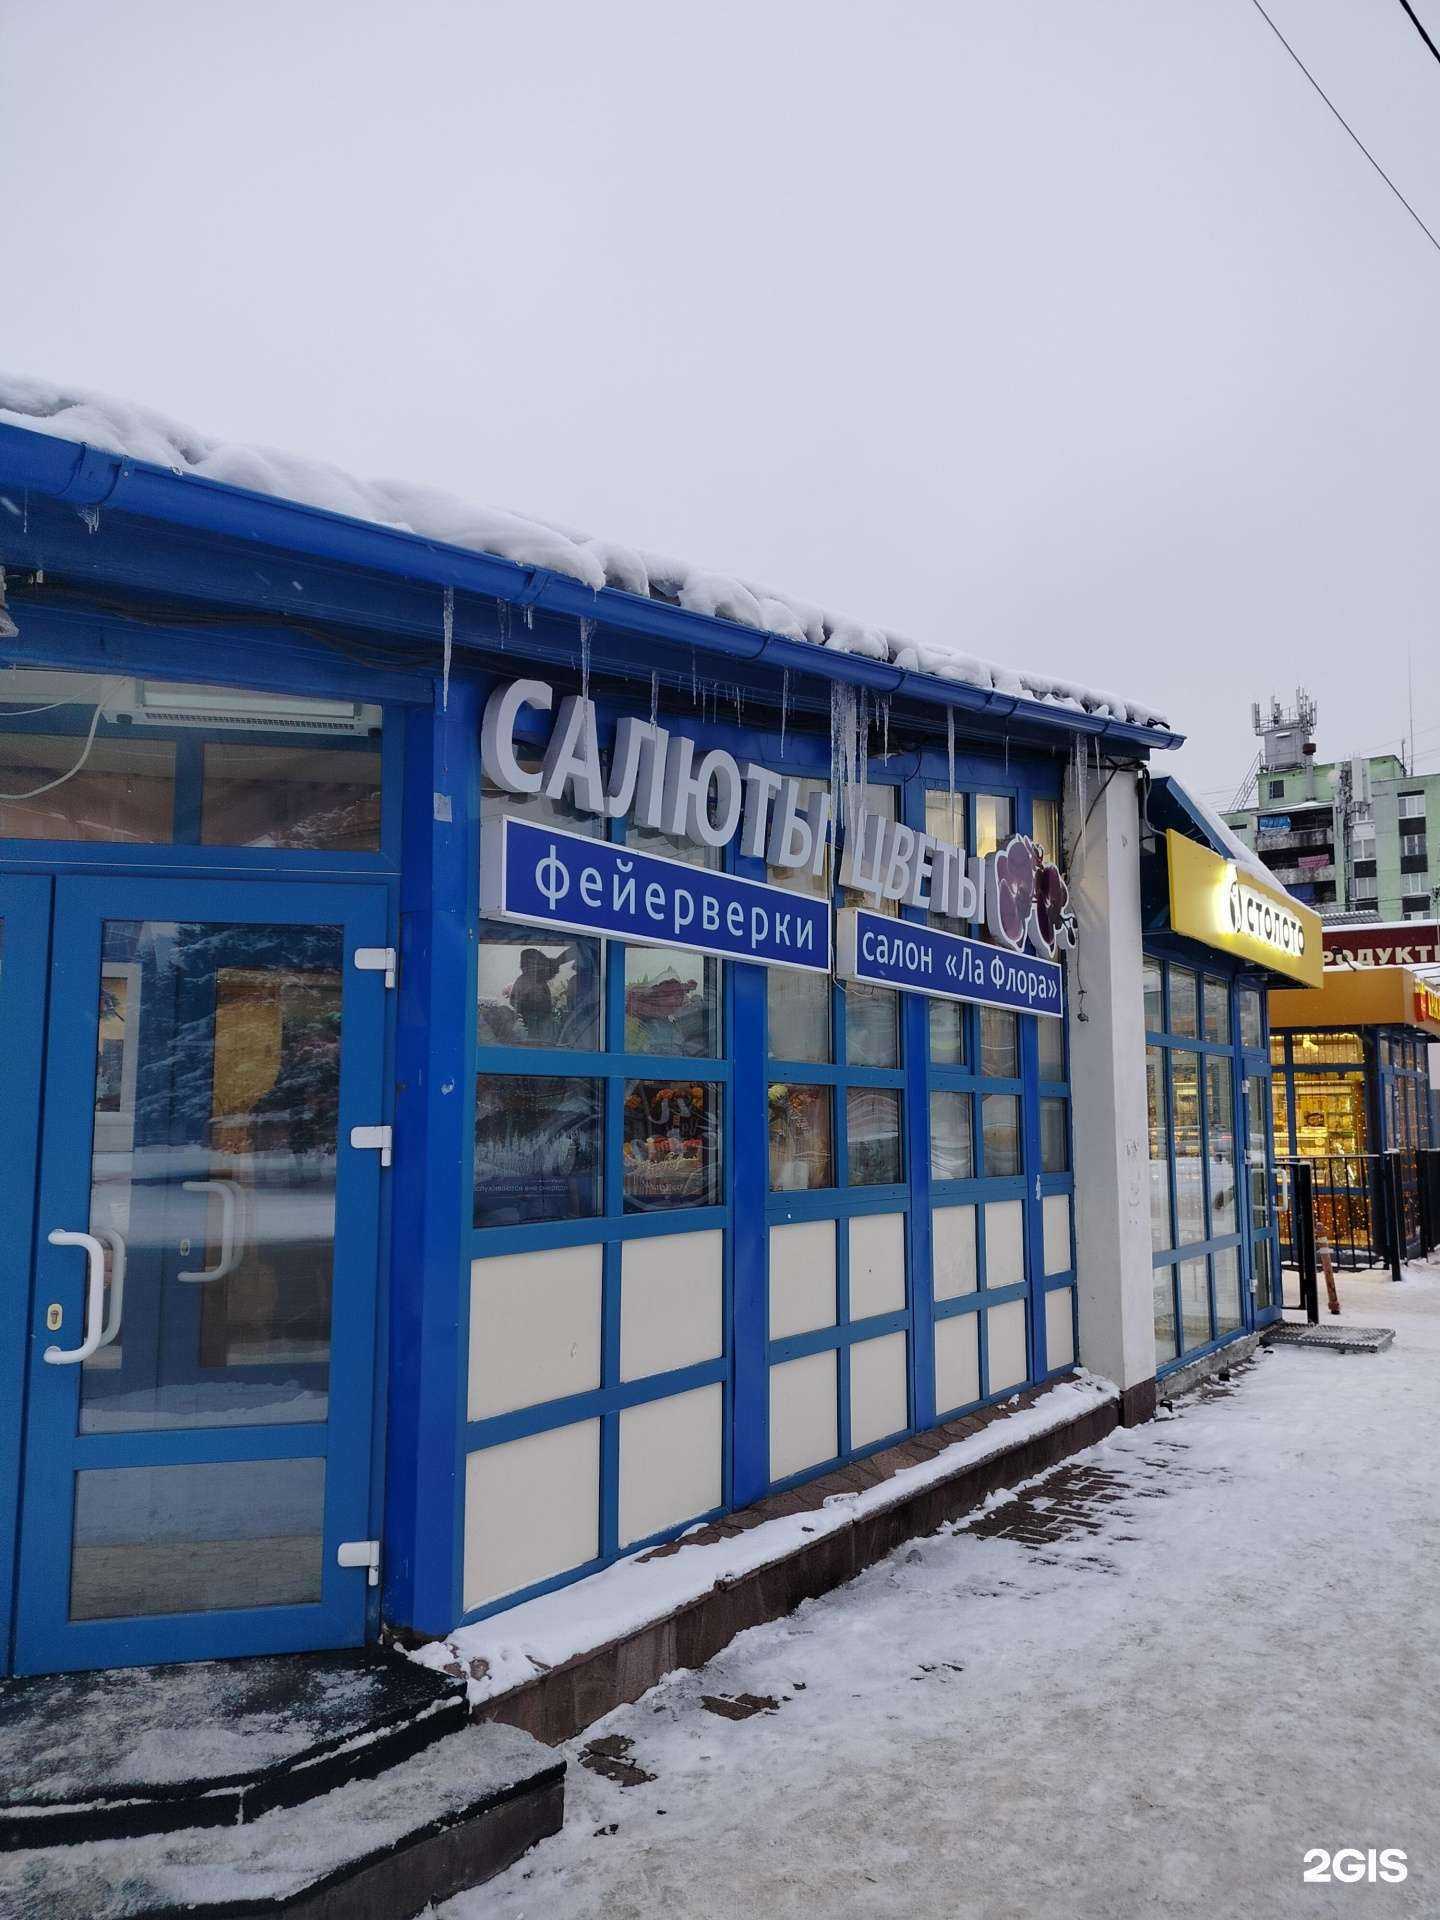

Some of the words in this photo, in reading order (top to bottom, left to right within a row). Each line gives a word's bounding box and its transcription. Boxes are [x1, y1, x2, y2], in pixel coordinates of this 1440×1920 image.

[481, 679, 832, 877] САЛЮТЫ
[535, 845, 814, 951] фейерверки
[839, 807, 986, 925] ЦВЕТЫ
[861, 930, 933, 974] салон
[944, 947, 984, 986] «Ла
[990, 954, 1058, 1005] Флора»
